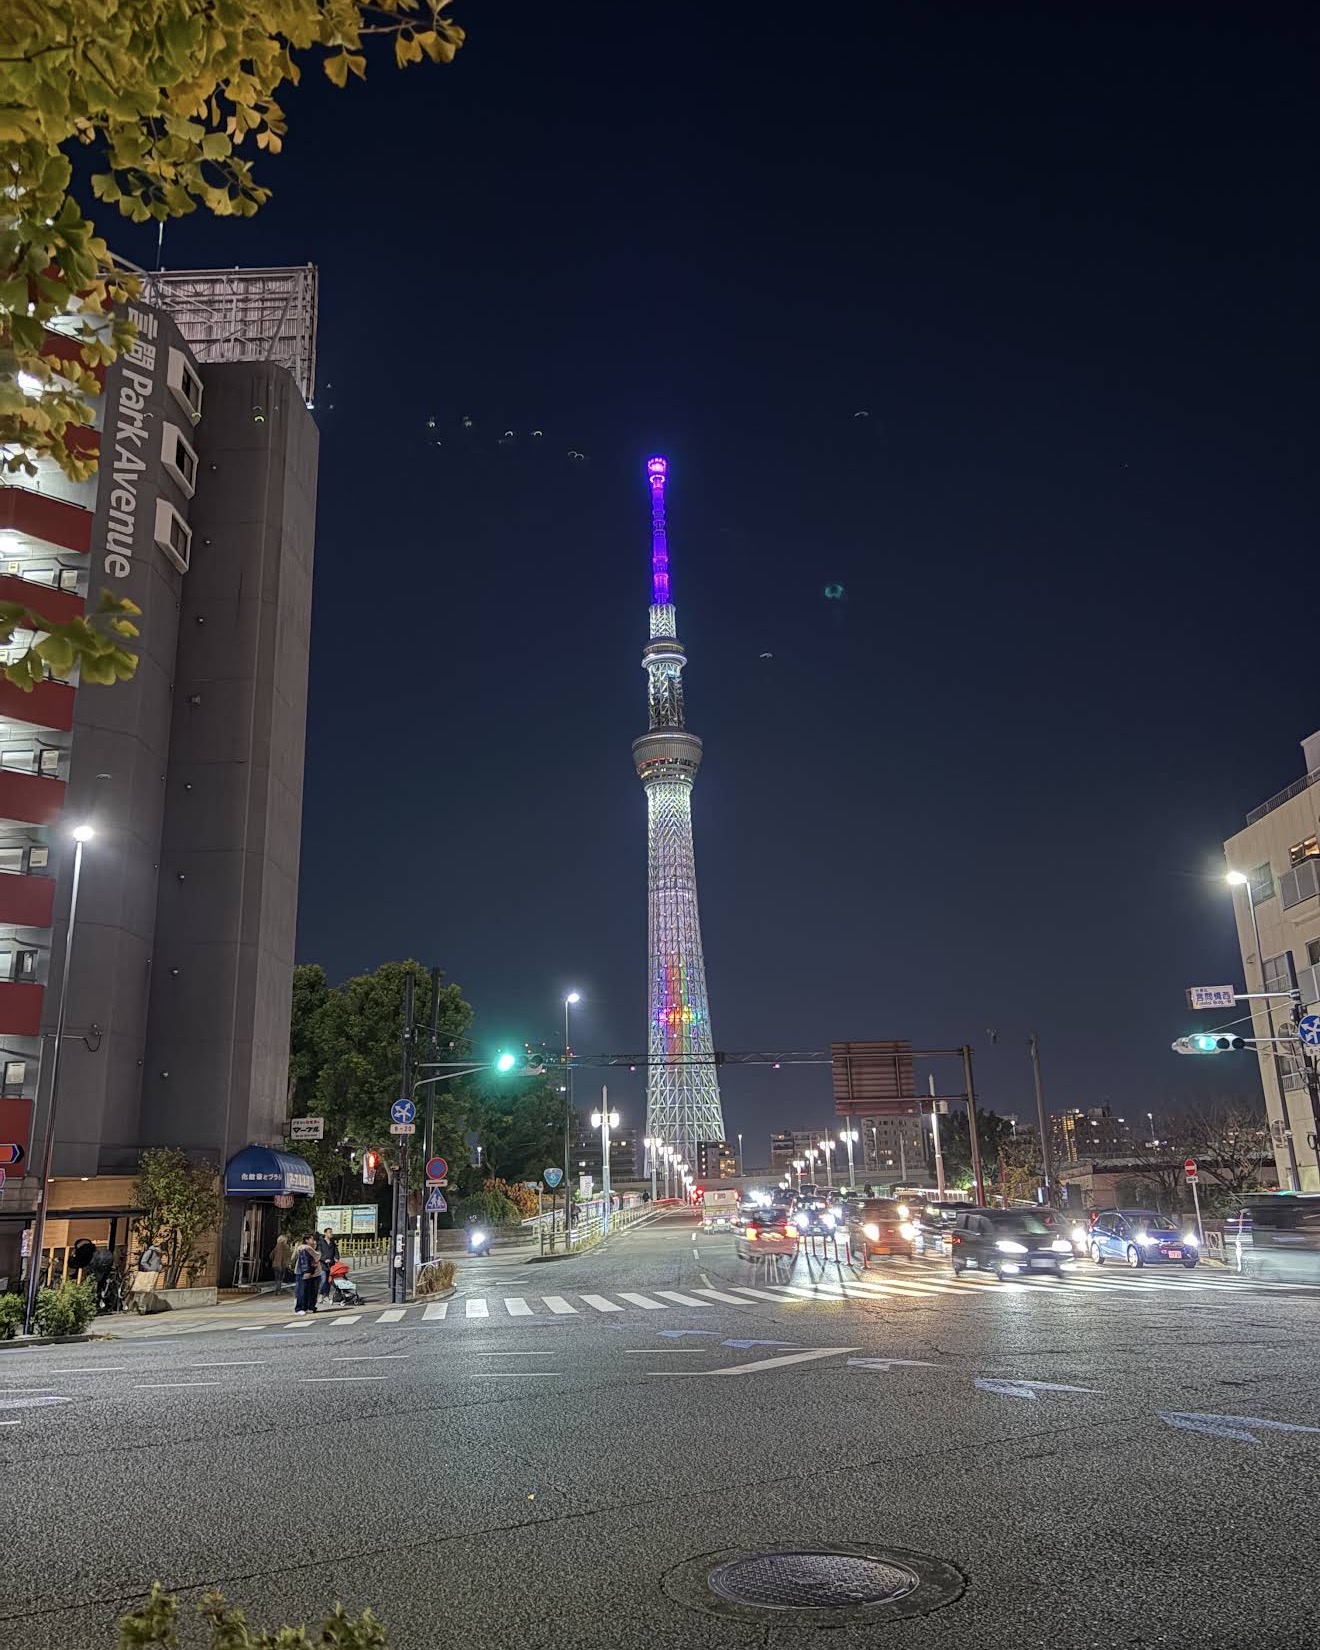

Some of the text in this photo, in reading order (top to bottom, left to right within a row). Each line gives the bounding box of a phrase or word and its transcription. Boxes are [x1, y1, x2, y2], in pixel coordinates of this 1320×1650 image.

[116, 368, 153, 448] Park
[104, 444, 147, 578] Avenue
[1196, 991, 1231, 1002] 言問橋西
